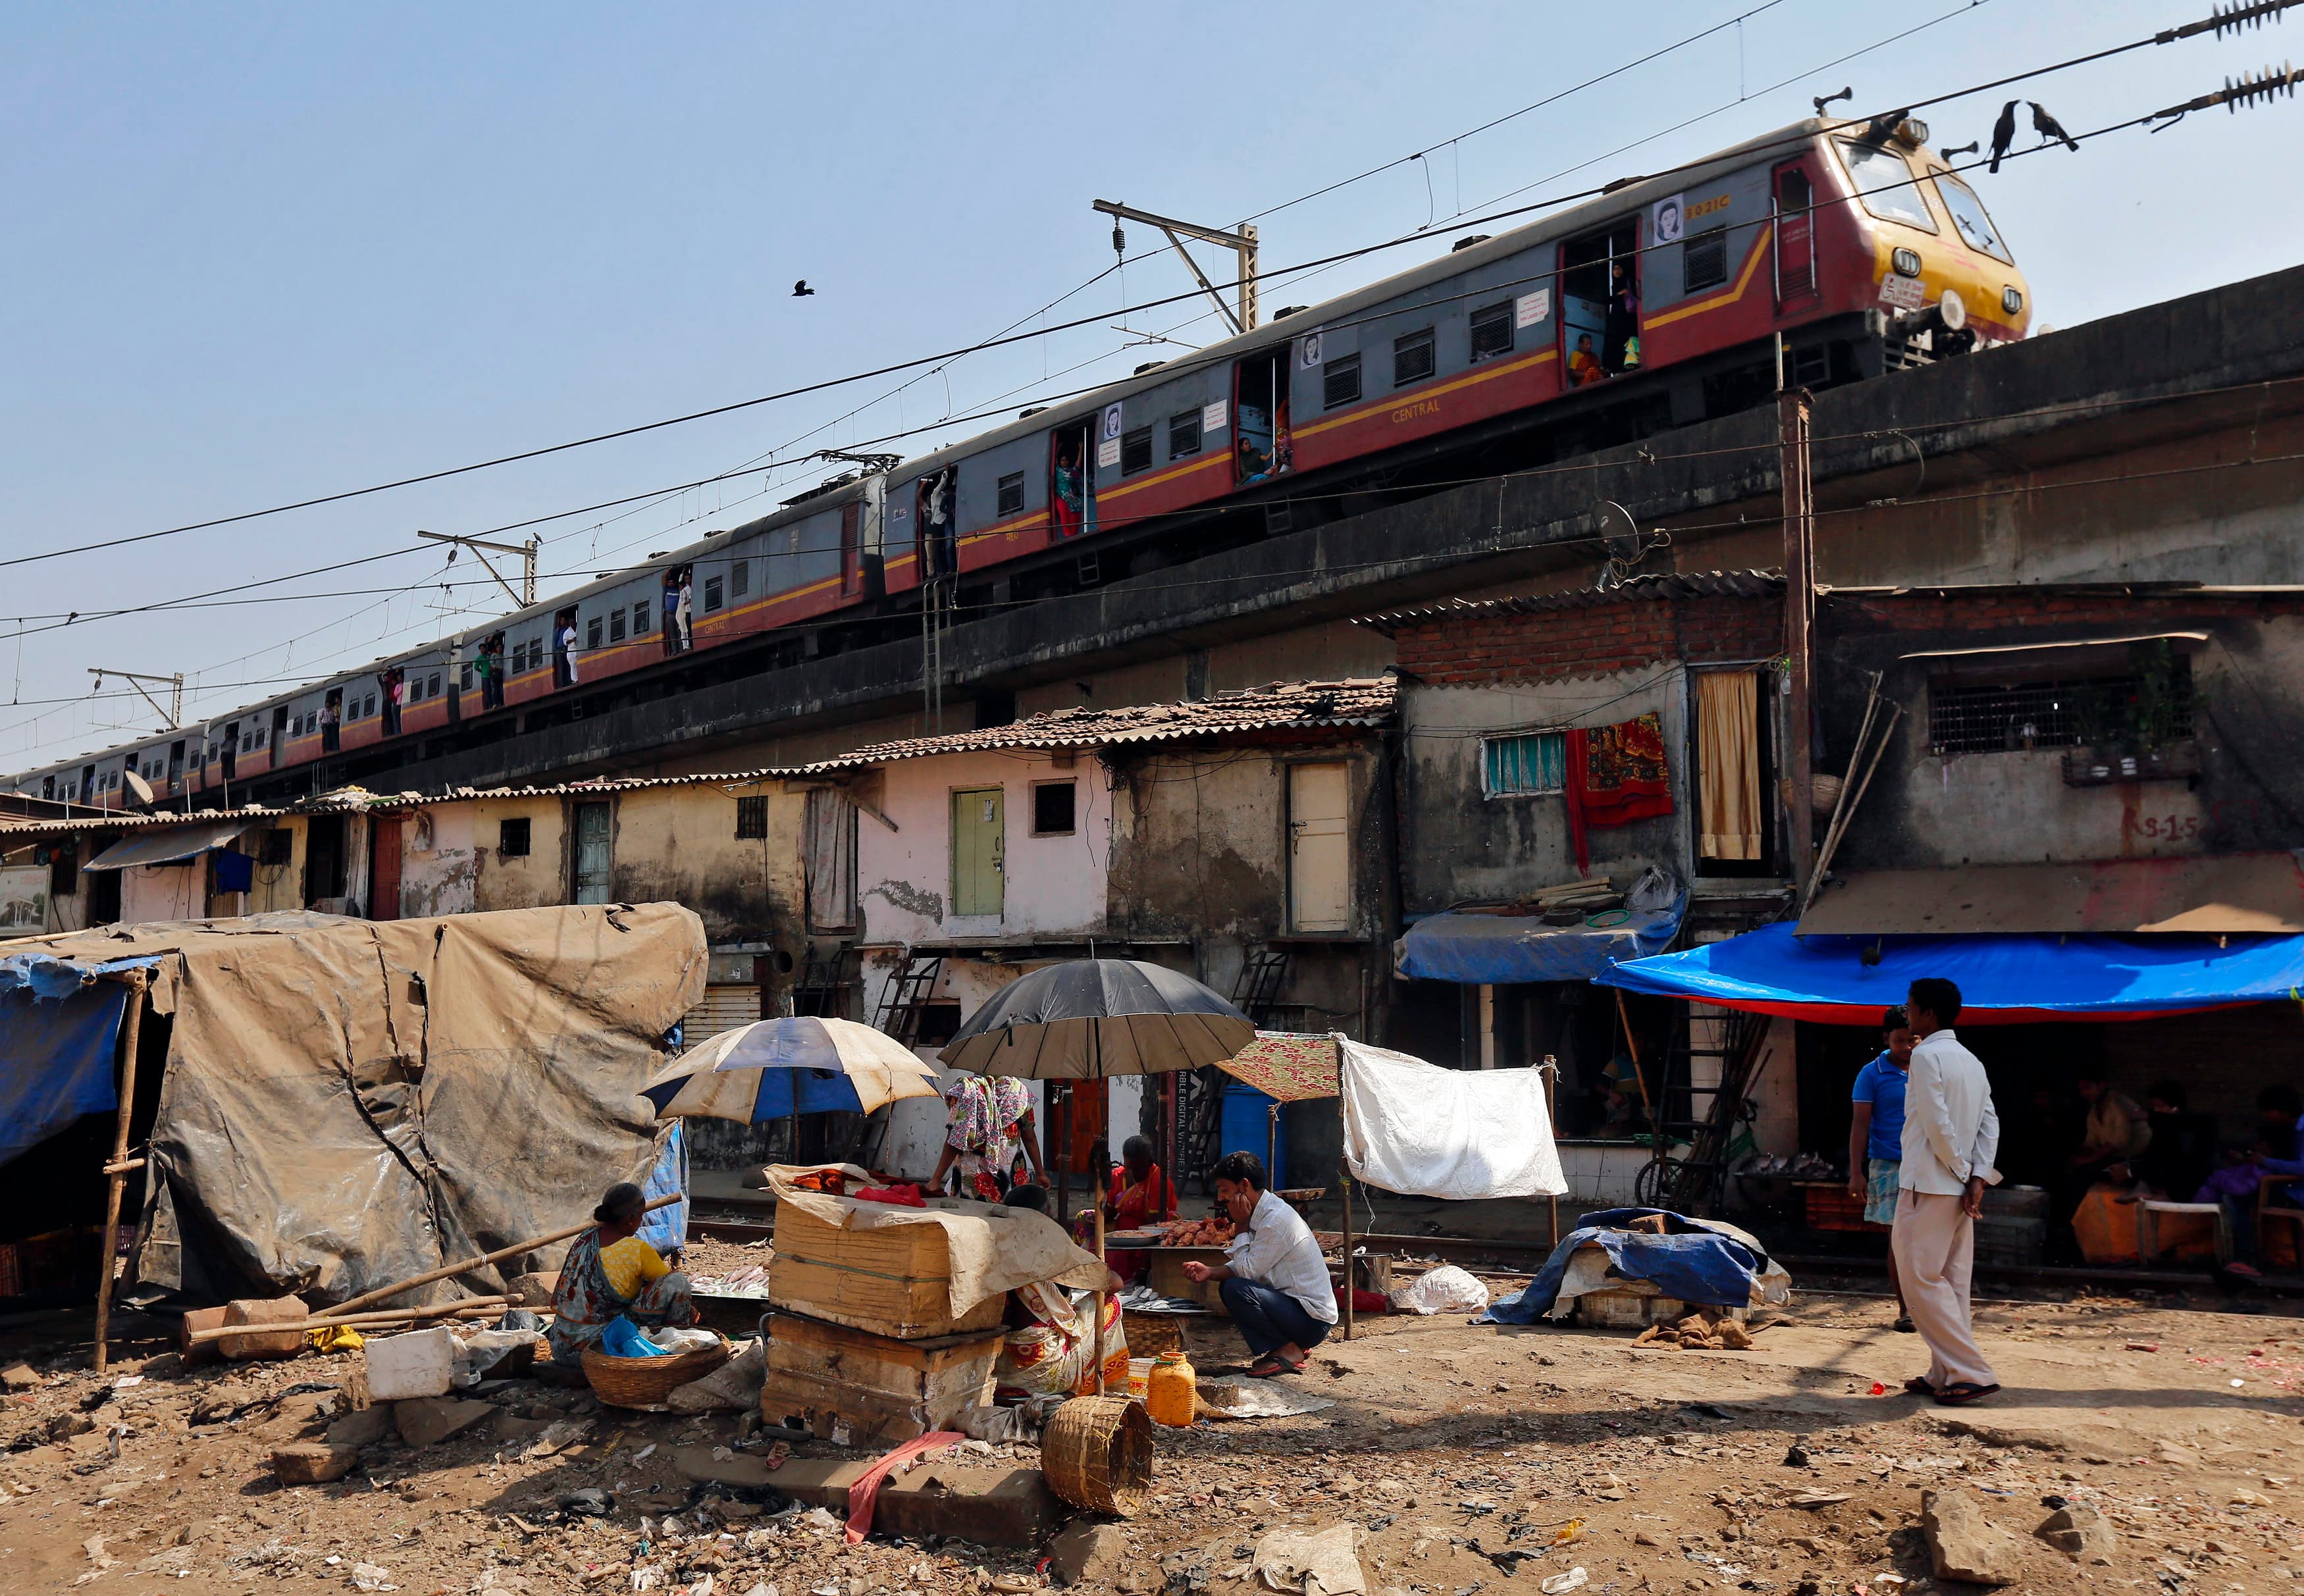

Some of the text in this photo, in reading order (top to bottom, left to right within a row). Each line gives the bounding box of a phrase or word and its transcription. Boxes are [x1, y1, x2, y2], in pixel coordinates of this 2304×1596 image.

[1686, 195, 1728, 219] 3021C
[1392, 399, 1440, 423] CENTRAL
[704, 621, 725, 634] CENTRAL
